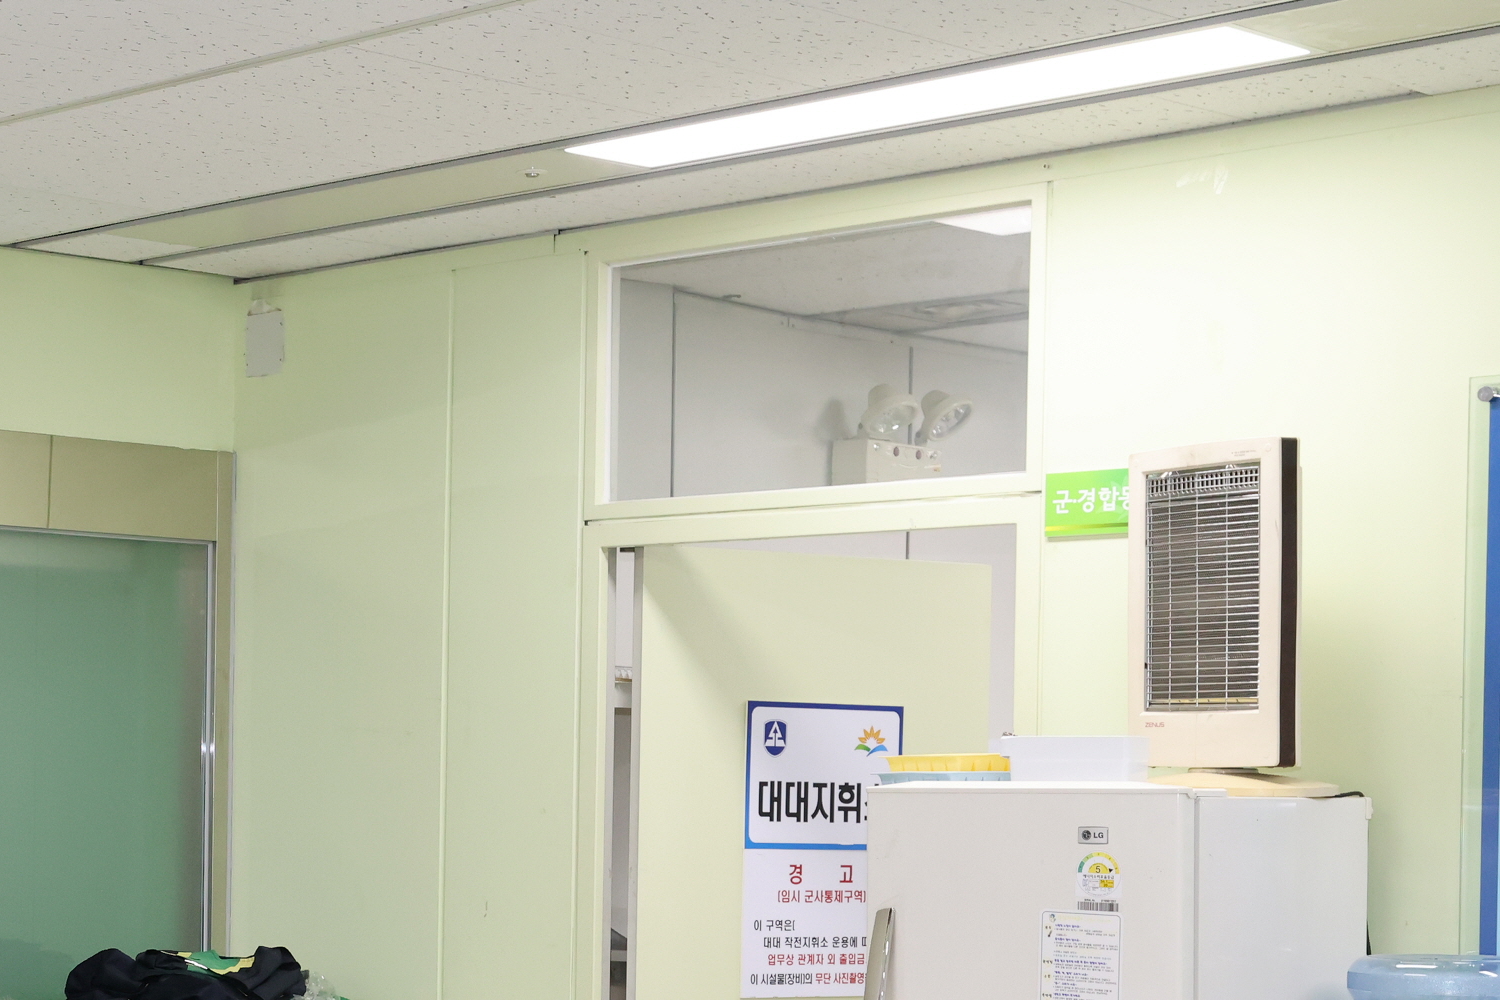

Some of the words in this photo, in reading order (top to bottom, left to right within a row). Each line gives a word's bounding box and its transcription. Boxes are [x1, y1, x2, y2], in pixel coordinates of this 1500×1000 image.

[758, 781, 867, 823] 대대지휘
[1095, 865, 1101, 873] 5
[778, 890, 800, 903] (임시
[753, 920, 761, 931] 이
[763, 937, 780, 948] 대대
[784, 937, 828, 948] 작전지휘소
[832, 937, 858, 948] 운용에
[767, 954, 794, 966] 업무상
[798, 954, 824, 965] 관계자
[827, 953, 836, 965] 외
[839, 953, 867, 965] 출입금
[750, 974, 758, 985] 이
[815, 973, 831, 984] 무단
[833, 972, 867, 984] 사진촬영
